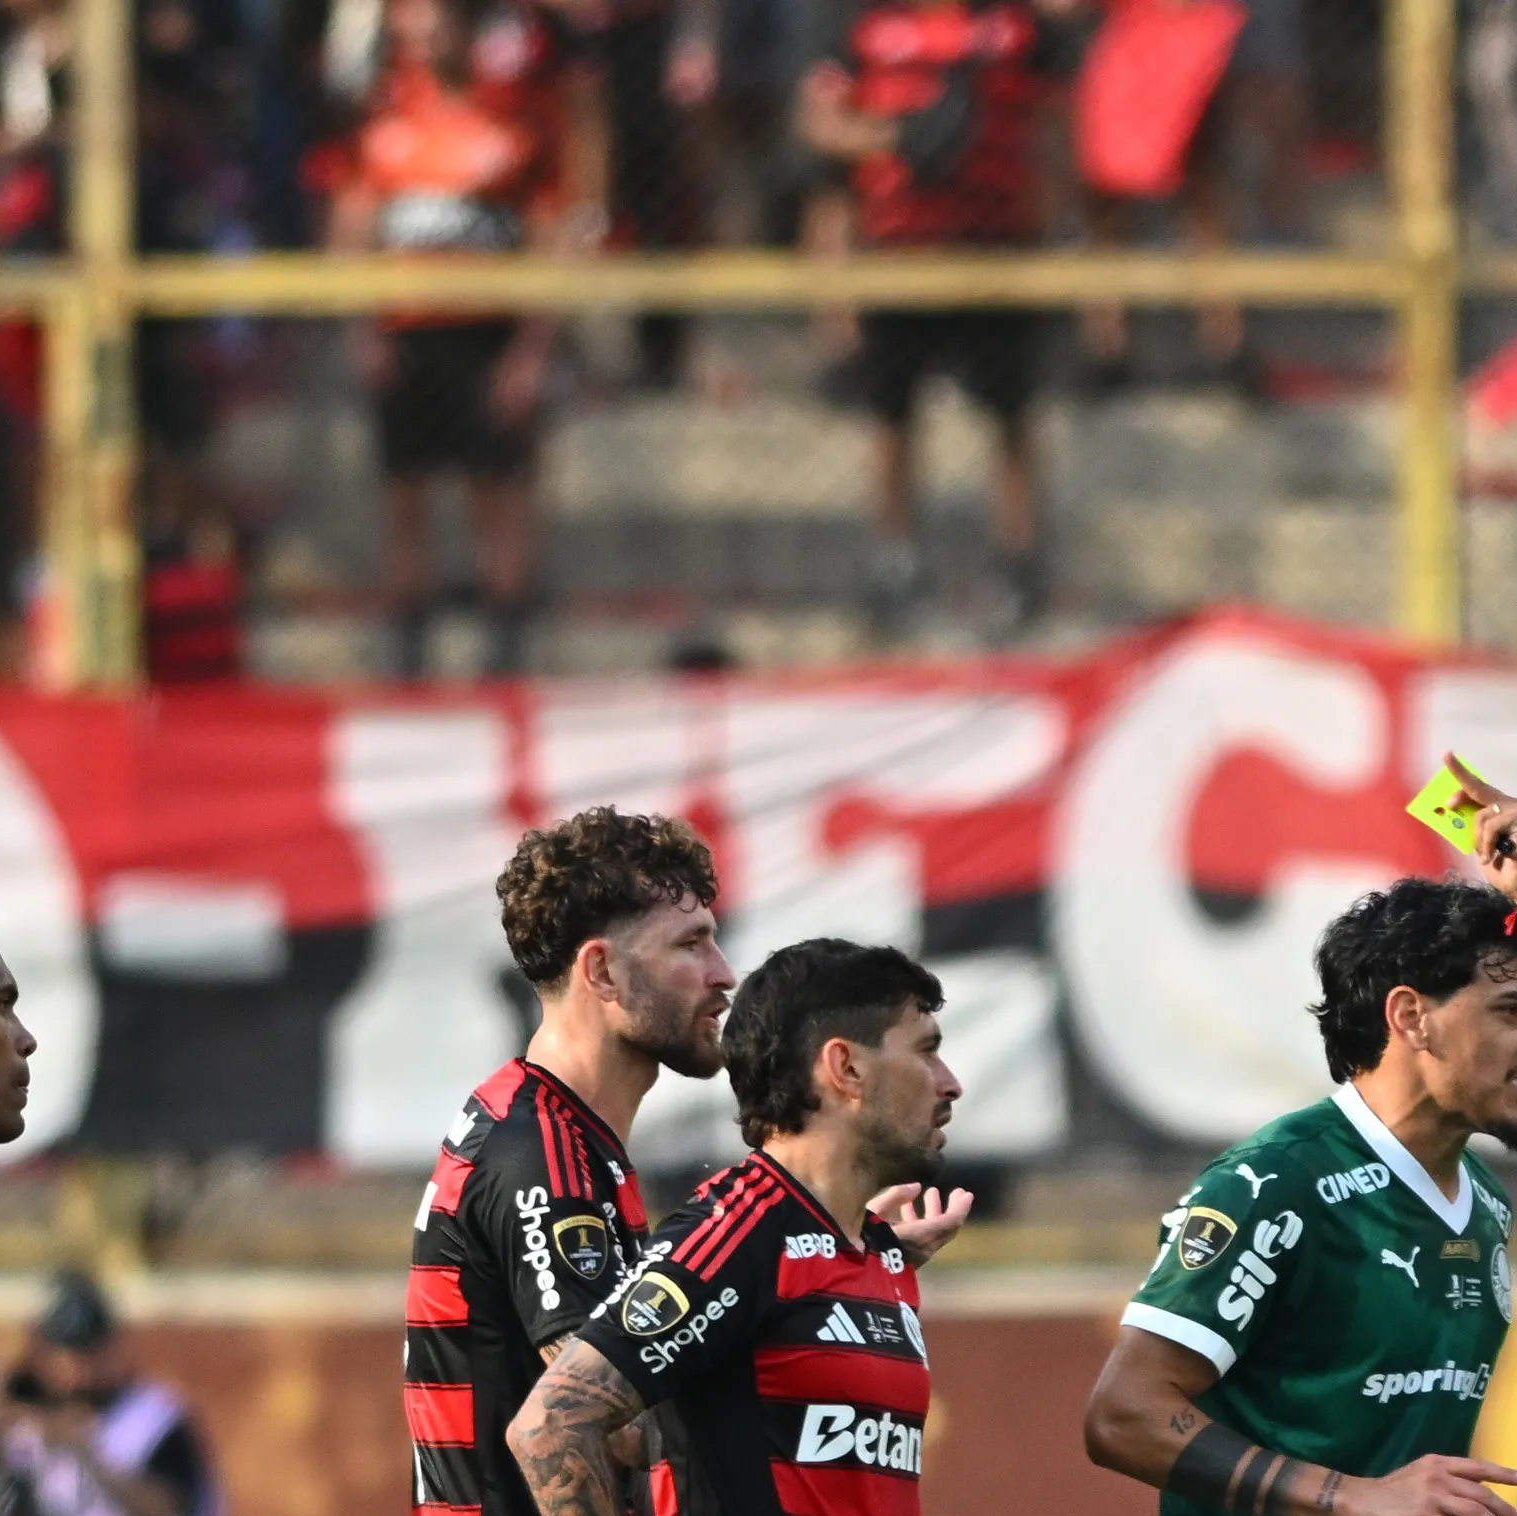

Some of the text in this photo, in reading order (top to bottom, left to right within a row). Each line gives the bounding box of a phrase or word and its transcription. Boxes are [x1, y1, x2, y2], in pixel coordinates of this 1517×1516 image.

[1316, 1162, 1391, 1204] CIMED
[515, 1186, 561, 1311] Shopee
[639, 1287, 740, 1375] Shopee
